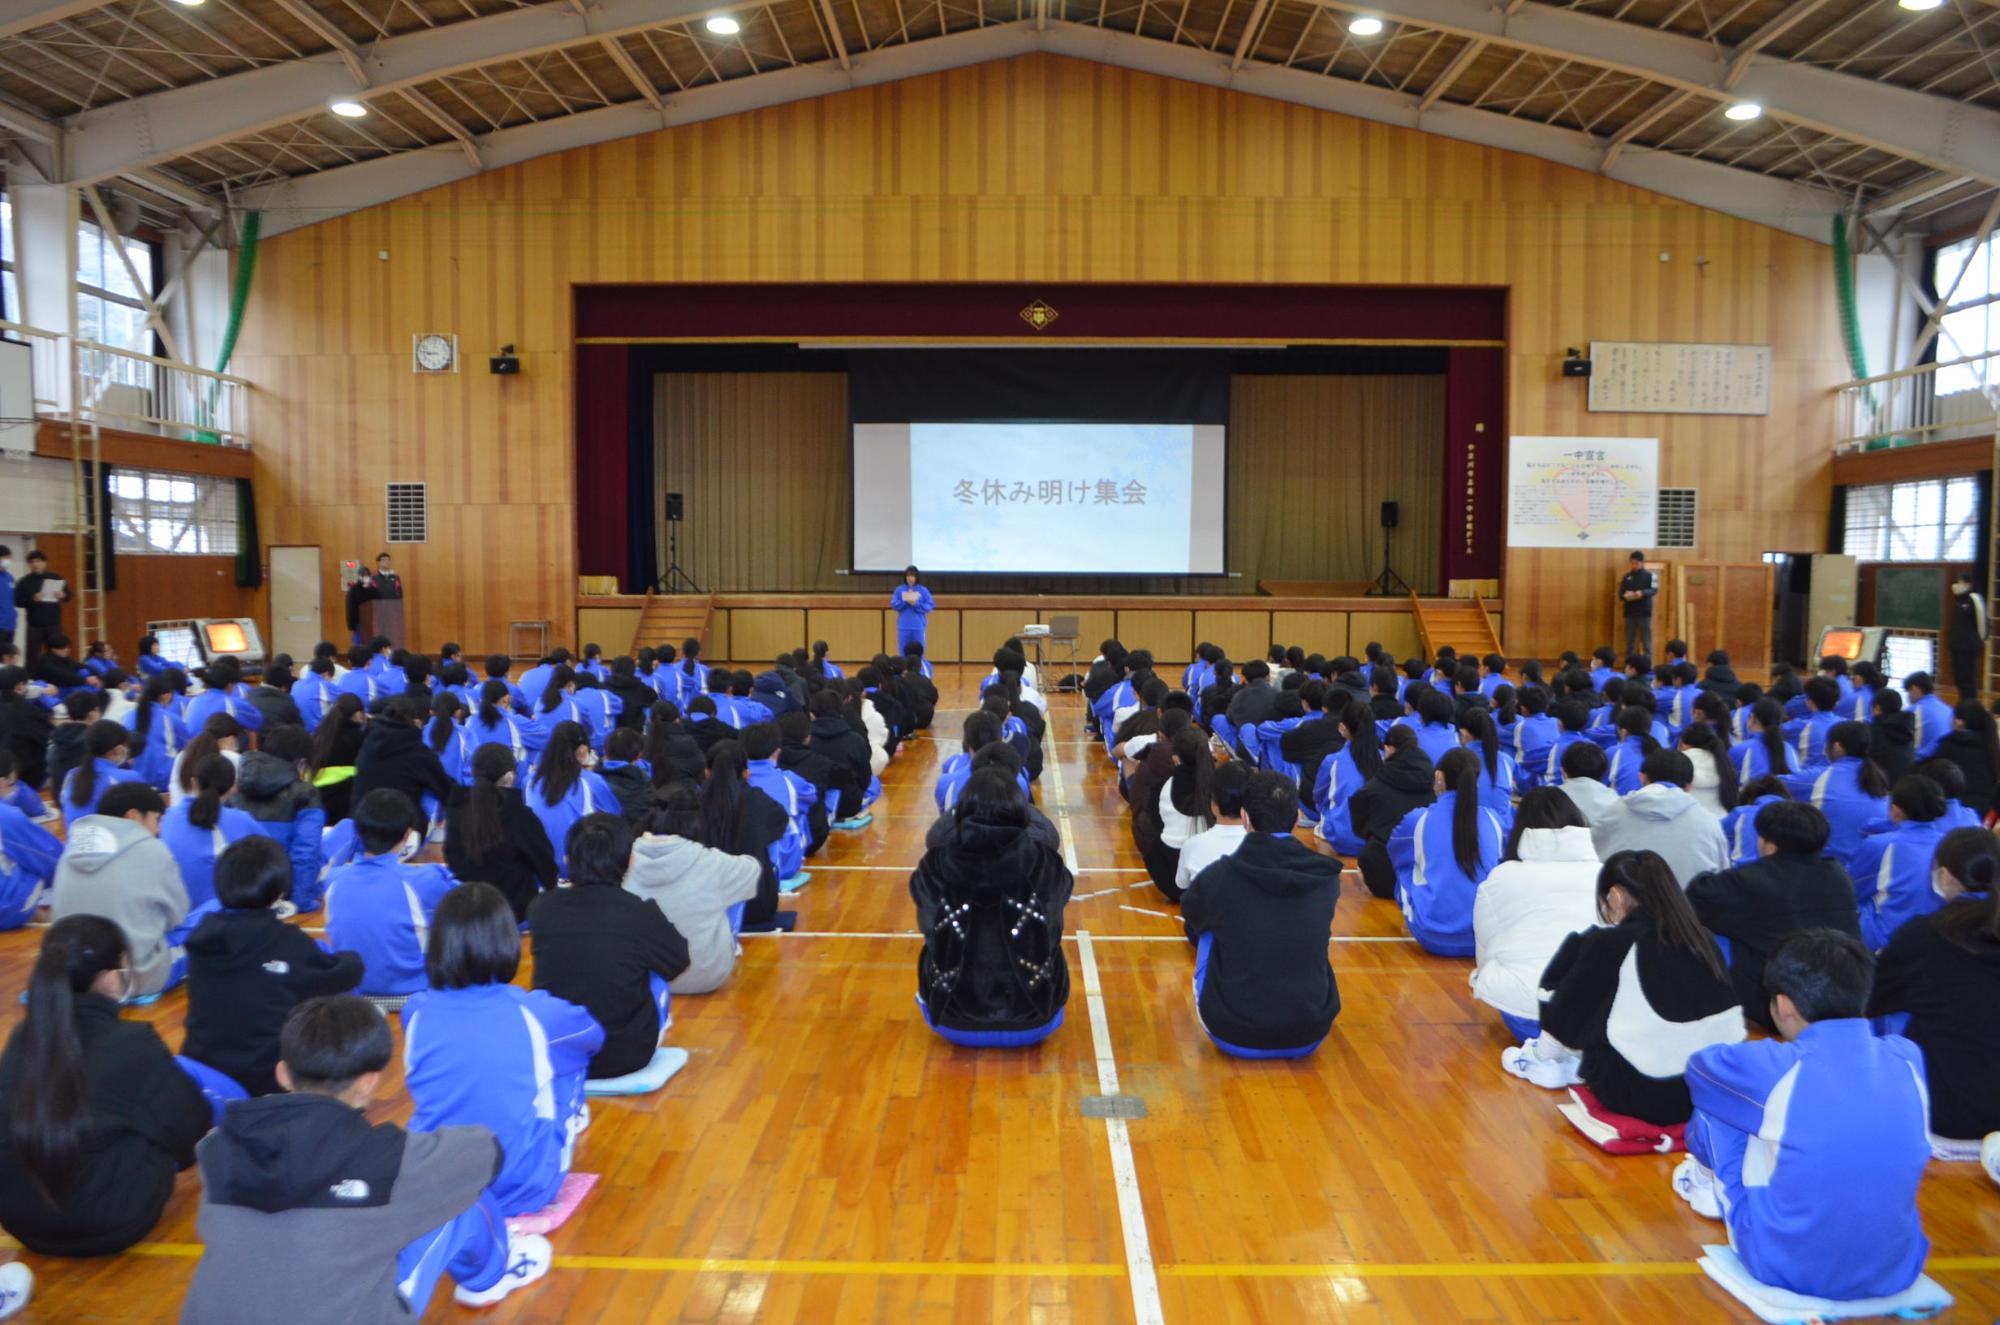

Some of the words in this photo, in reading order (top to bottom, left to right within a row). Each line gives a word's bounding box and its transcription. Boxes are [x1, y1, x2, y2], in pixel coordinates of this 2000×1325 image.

[1563, 450, 1606, 461] 一中宣言
[953, 478, 1147, 505] 冬休み明け集会
